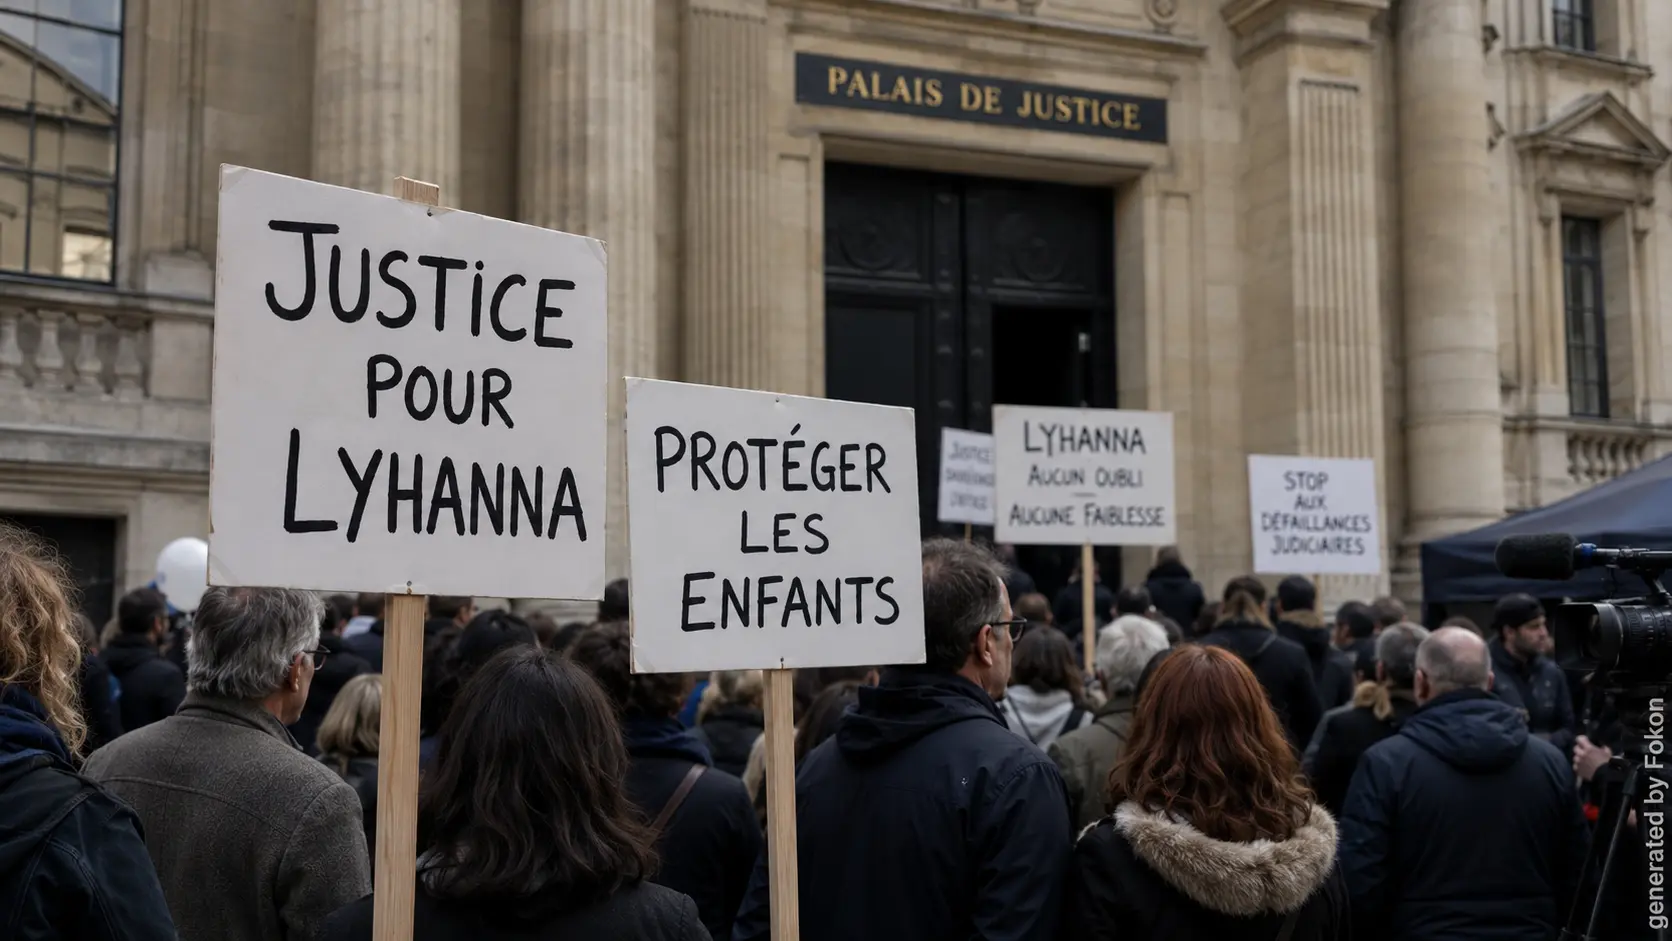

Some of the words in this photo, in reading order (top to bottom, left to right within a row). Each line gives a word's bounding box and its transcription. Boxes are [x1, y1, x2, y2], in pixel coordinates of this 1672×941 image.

[828, 66, 942, 106] PALAIS
[961, 83, 1002, 114] DE
[1018, 91, 1141, 130] JUSTICE
[367, 354, 514, 429] POUR
[1023, 419, 1147, 457] LYHANNA
[654, 423, 891, 494] PROTÉGER
[1028, 464, 1085, 489] AUCUN
[1095, 466, 1144, 489] OUBLI
[284, 428, 587, 543] LYHANNA
[1283, 470, 1329, 492] STOP
[1009, 503, 1075, 527] AUCUNE
[1083, 503, 1165, 528] FAIBLESSE
[1293, 494, 1328, 511] AUX
[741, 510, 830, 555] LES
[1260, 510, 1372, 534] DÉFAILLANCES
[1270, 534, 1366, 557] JUDICIAIRES
[681, 571, 900, 633] ENFANTS
